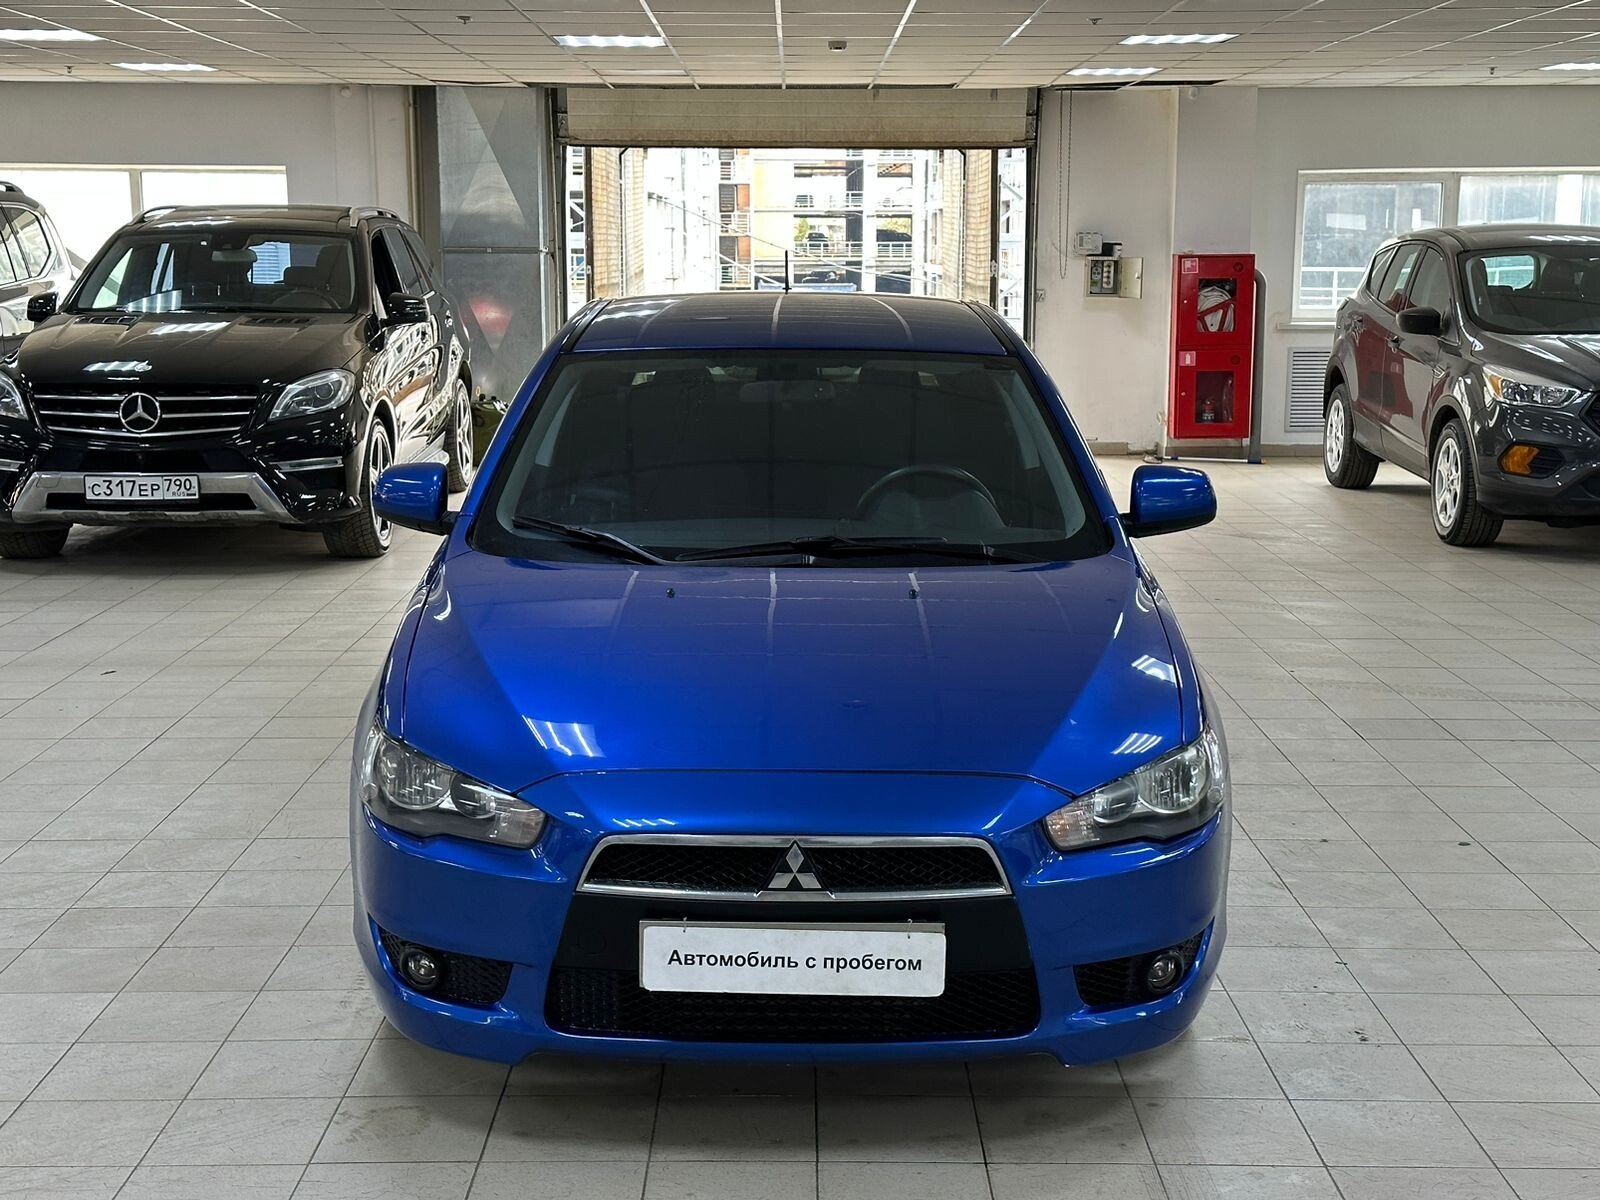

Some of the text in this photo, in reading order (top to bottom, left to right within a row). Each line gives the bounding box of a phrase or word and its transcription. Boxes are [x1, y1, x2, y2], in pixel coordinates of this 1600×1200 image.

[164, 478, 192, 492] 790
[668, 949, 923, 973] Автомобиль с пробегом
